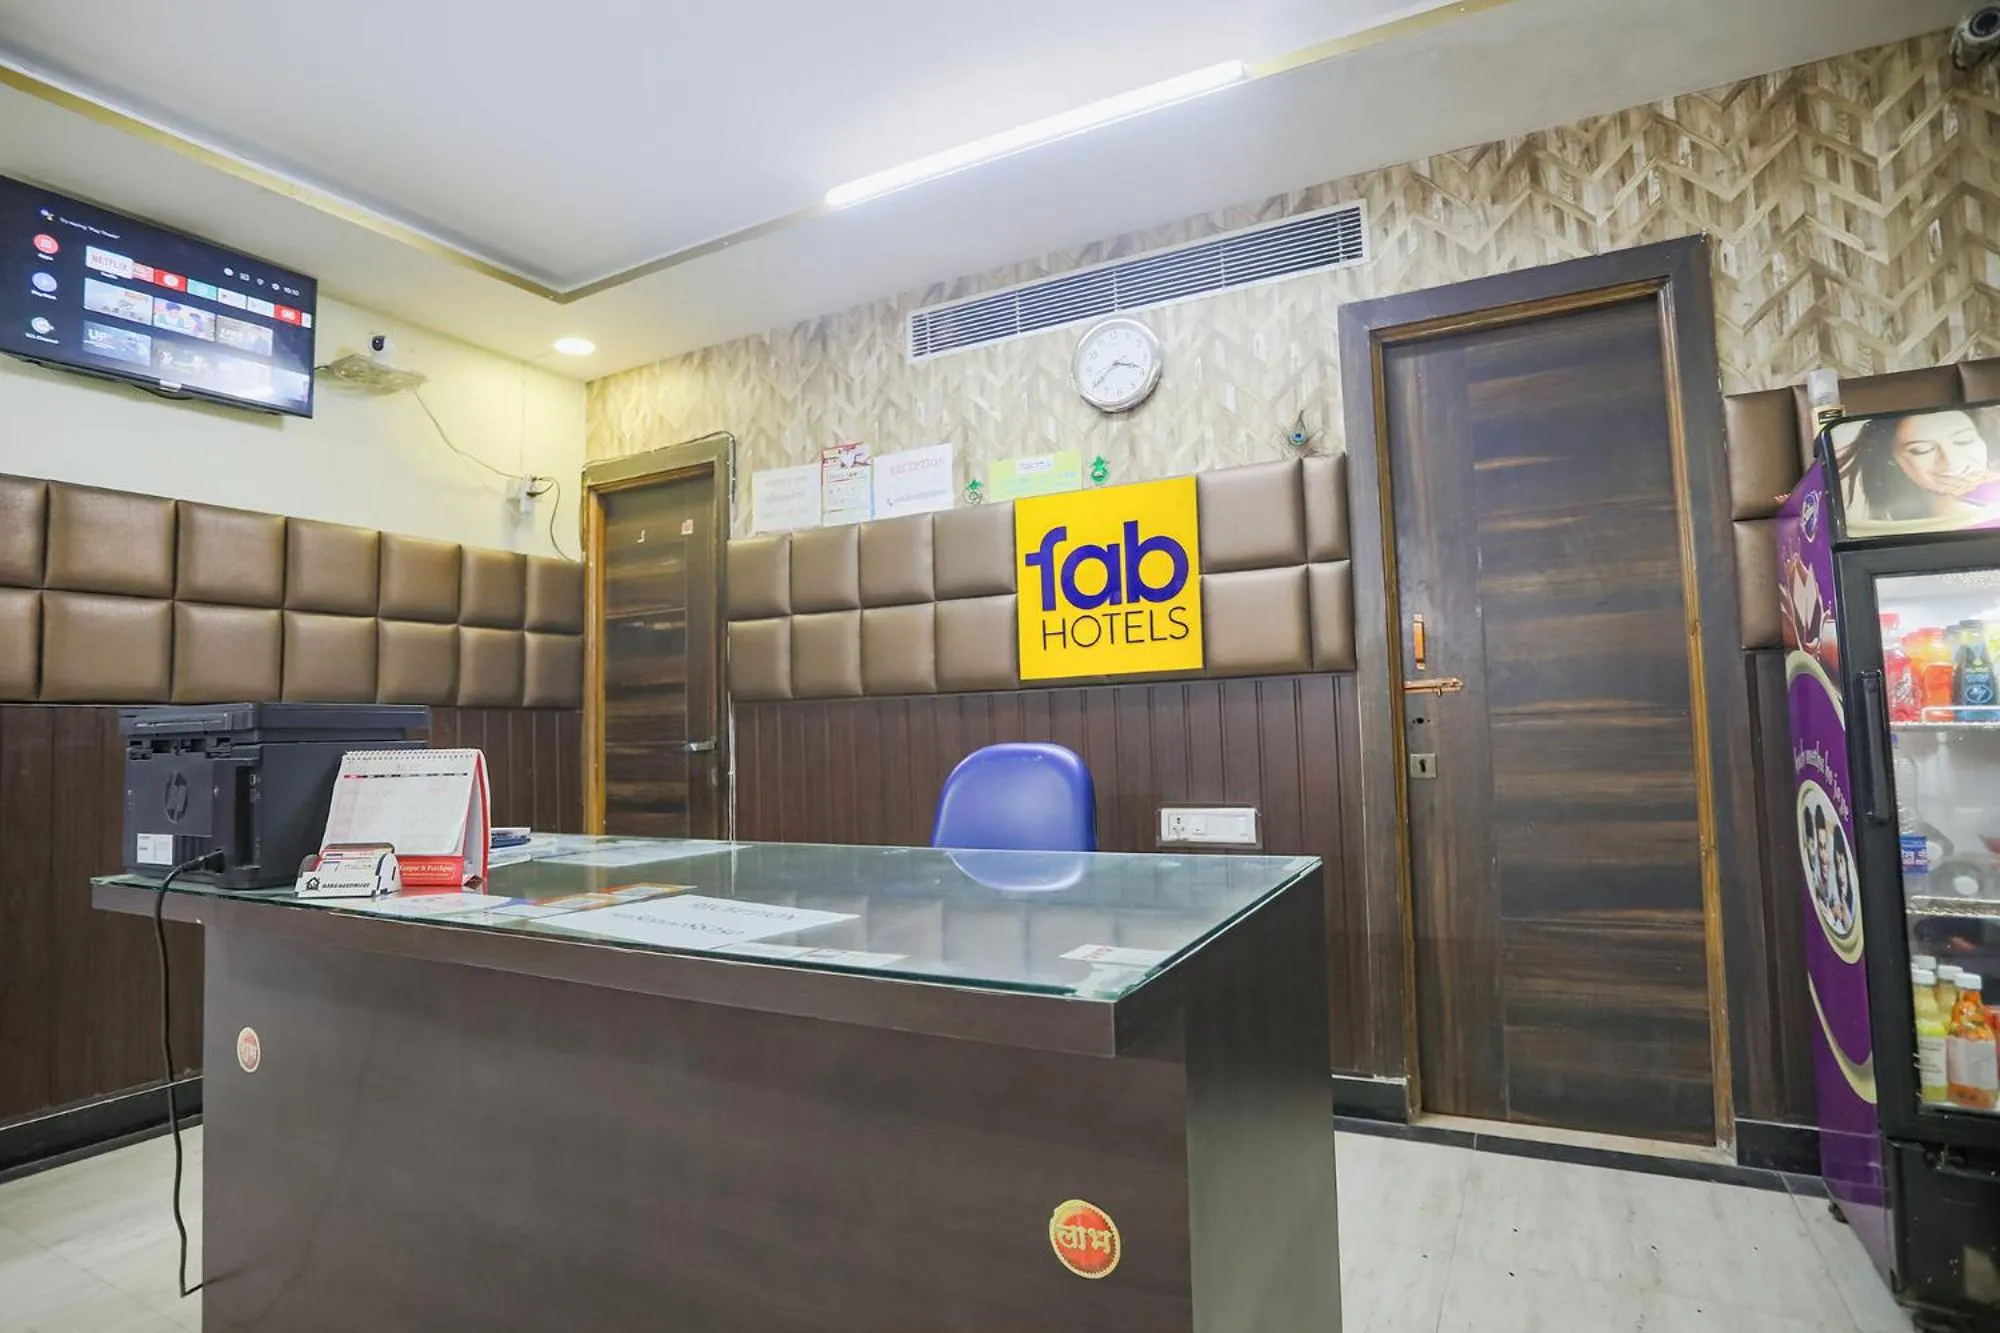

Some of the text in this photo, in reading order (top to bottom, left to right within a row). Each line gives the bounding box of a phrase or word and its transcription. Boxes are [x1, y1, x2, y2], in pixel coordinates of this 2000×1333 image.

[91, 253, 129, 272] NETFLIX
[1025, 519, 1189, 612] fab
[1042, 606, 1190, 651] HOTELS
